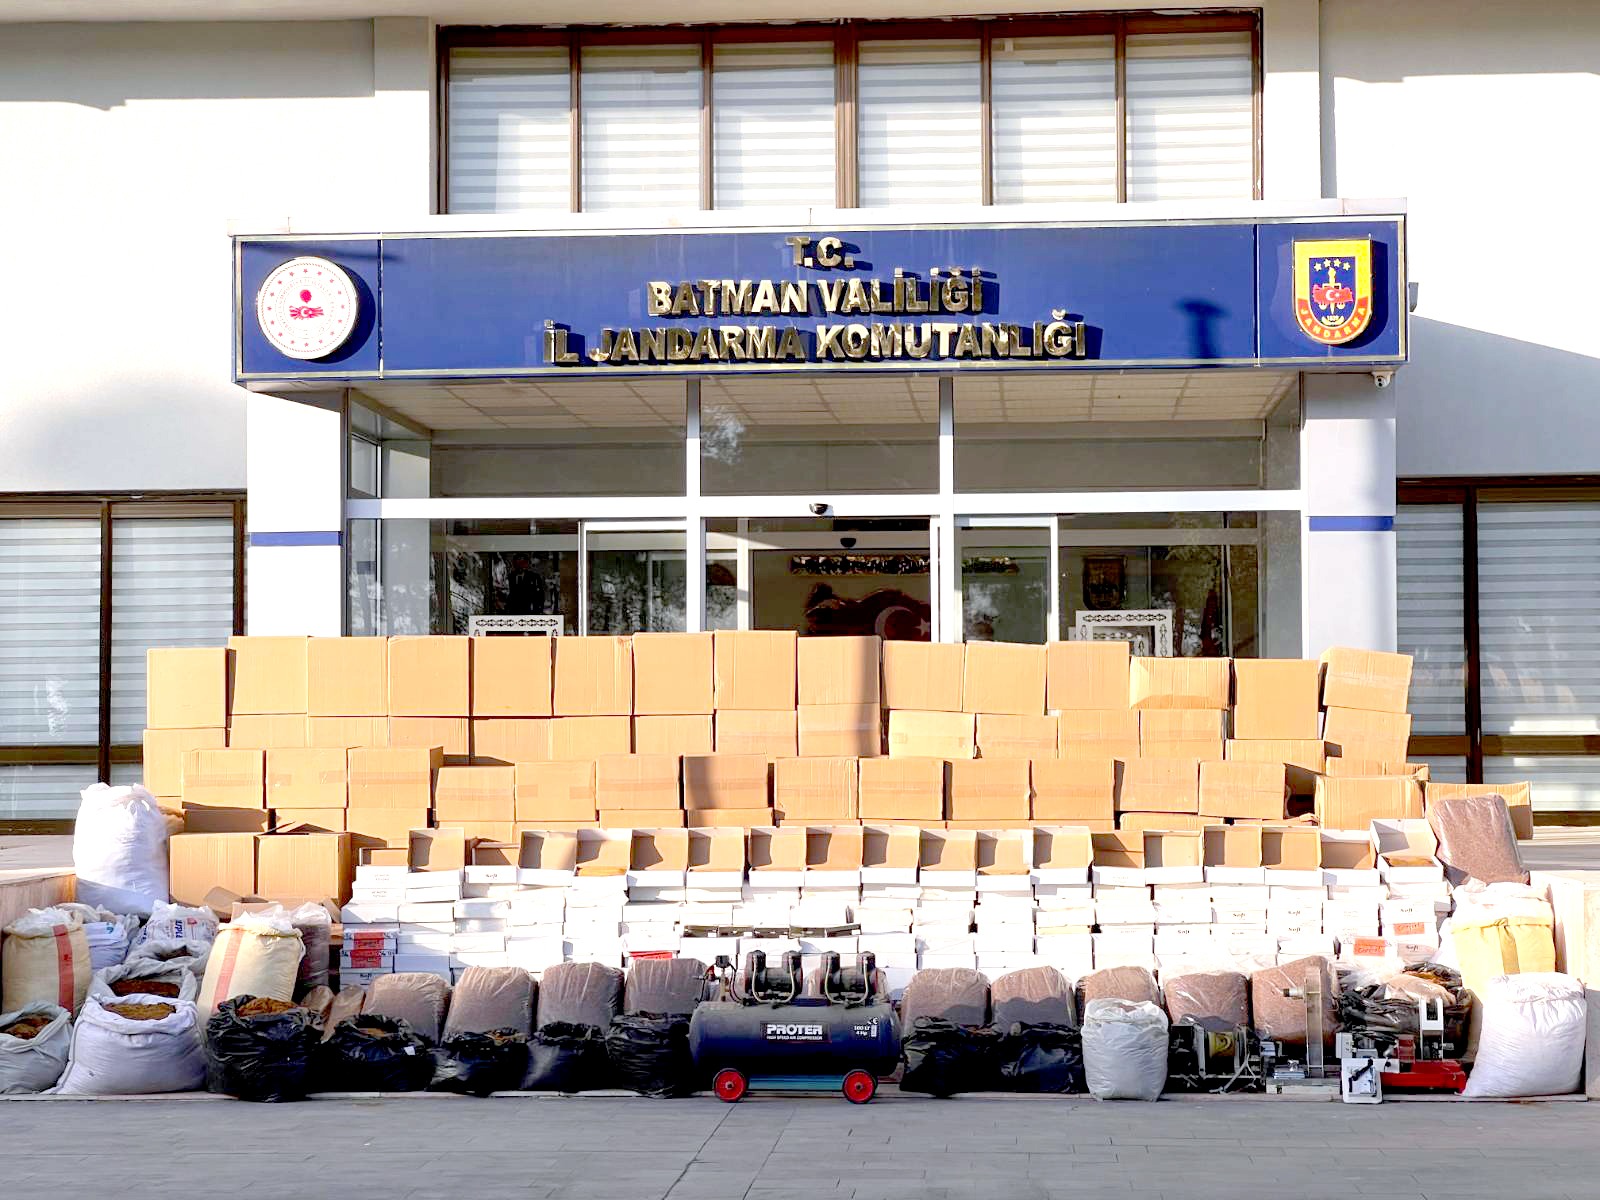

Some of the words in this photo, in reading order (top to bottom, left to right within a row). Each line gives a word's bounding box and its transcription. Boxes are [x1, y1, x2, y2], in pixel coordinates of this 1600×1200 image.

[786, 236, 854, 267] T.C.
[647, 279, 807, 315] BATMAN
[818, 268, 982, 312] VALİLİĞİ
[543, 320, 579, 362] İL
[590, 325, 806, 361] JANDARMA
[816, 308, 1086, 358] KOMUTANLIĞI
[1300, 306, 1366, 338] JANDARMA
[766, 1024, 823, 1035] PROTER
